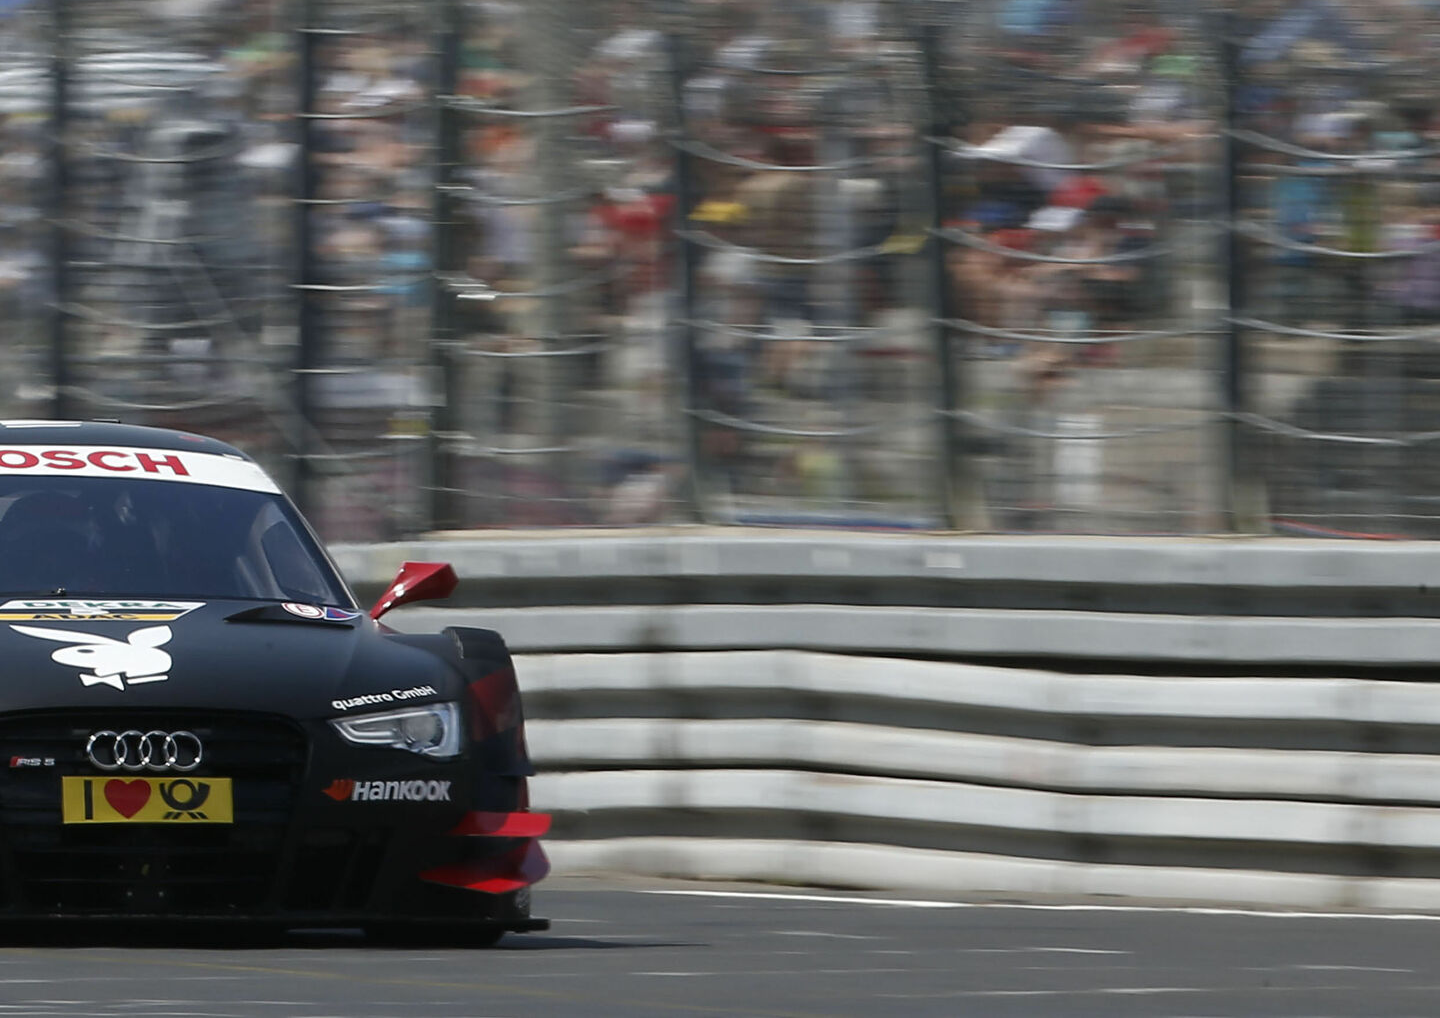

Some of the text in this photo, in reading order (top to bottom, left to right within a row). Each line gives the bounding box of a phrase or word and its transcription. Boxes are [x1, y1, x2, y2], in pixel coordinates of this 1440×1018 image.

[23, 601, 182, 609] DEKRA
[331, 685, 437, 710] quattro GmbH
[16, 757, 55, 766] RS 5
[83, 779, 94, 820] I
